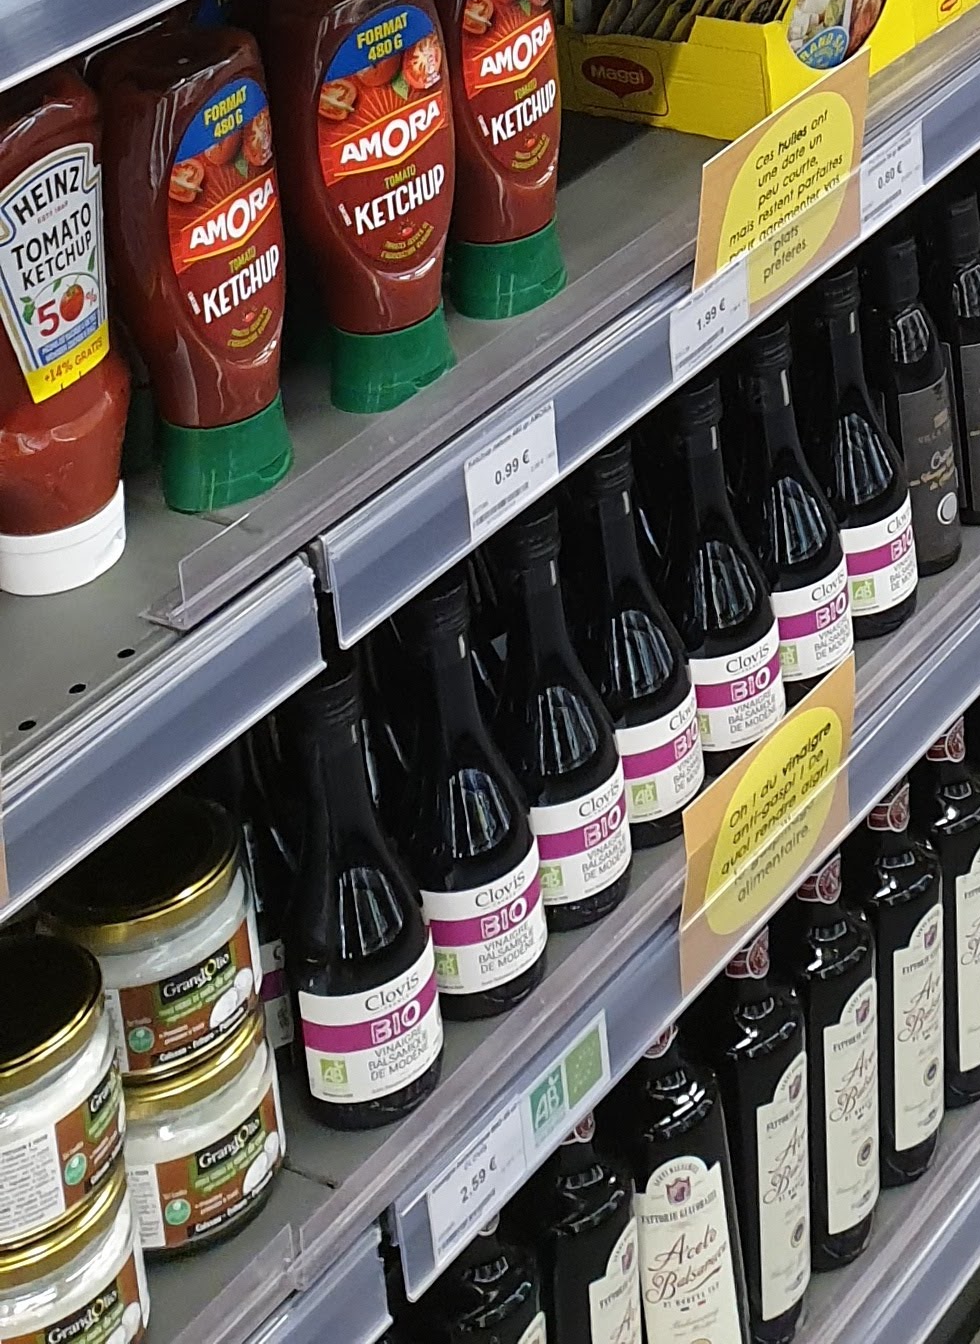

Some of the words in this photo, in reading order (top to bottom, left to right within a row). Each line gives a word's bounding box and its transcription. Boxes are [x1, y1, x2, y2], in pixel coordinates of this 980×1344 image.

[357, 12, 408, 48] FORMAT
[368, 40, 392, 61] 480
[480, 18, 552, 78] AMORA
[590, 63, 646, 87] Maggi
[340, 99, 441, 165] AMORA
[491, 80, 557, 145] KETCHUP
[755, 150, 775, 170] Ces
[777, 126, 807, 156] huiles
[811, 109, 828, 131] ont
[757, 166, 778, 188] une
[782, 146, 805, 170] date
[809, 133, 823, 149] un
[12, 166, 80, 225] HEINZ
[355, 163, 445, 235] KETCHUP
[384, 163, 416, 190] TOMATO
[757, 183, 779, 210] peu
[190, 178, 275, 249] AMORA
[729, 221, 755, 248] mais
[758, 189, 794, 225] restent
[797, 153, 843, 198] parfaites
[11, 202, 92, 271] TOMATO
[774, 224, 799, 255] plats
[21, 230, 92, 291] KETCHUP
[203, 245, 280, 324] KETCHUP
[696, 306, 718, 331] 1.99
[74, 337, 103, 365] GRATIS
[495, 458, 519, 485] 0.99
[725, 641, 770, 674] Clovis
[730, 666, 772, 702] BIO
[729, 805, 748, 828] Oh
[760, 773, 778, 798] du
[782, 722, 832, 777] vinaigre
[732, 772, 796, 845] anti-gaspi
[809, 749, 824, 769] De
[721, 837, 751, 875] quoi
[755, 794, 797, 843] rendre
[475, 870, 525, 908] Clovis
[480, 897, 528, 939] BIO
[364, 971, 420, 1011] Clovis
[371, 1000, 421, 1045] BIO
[460, 1169, 486, 1203] 2.59
